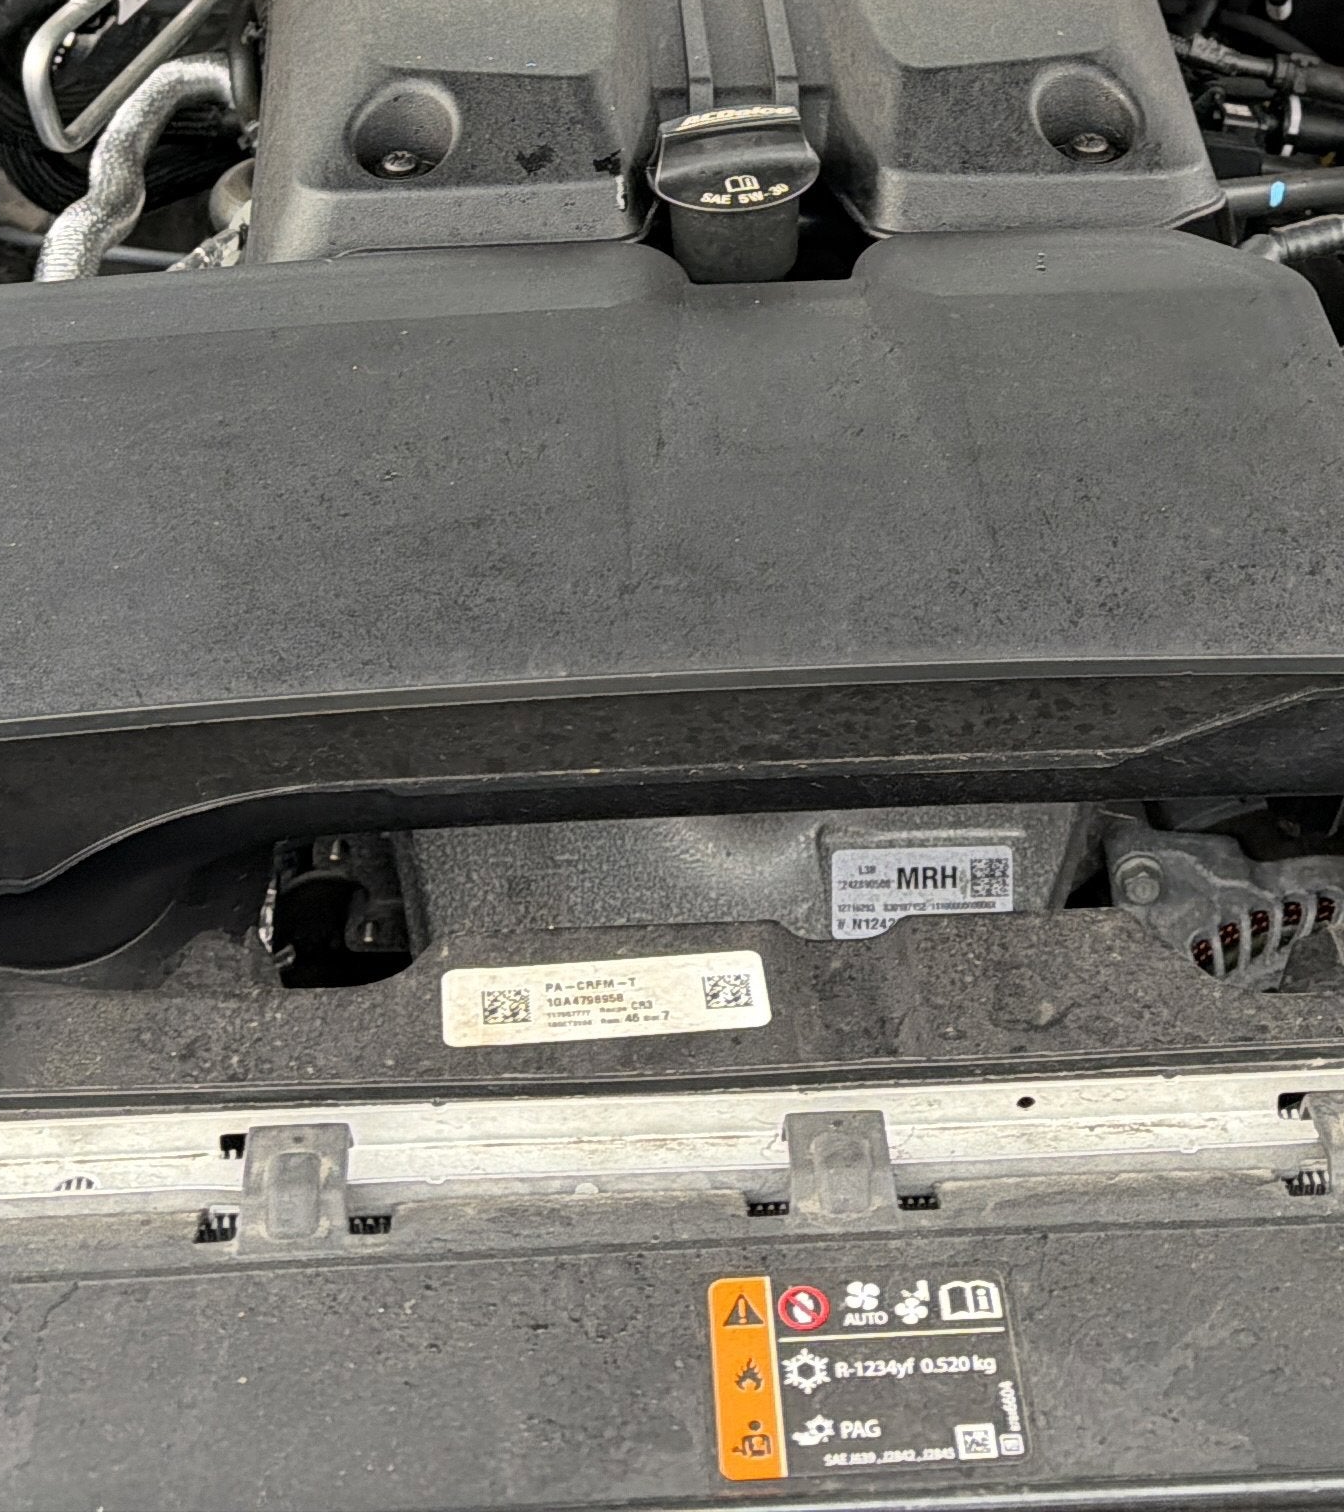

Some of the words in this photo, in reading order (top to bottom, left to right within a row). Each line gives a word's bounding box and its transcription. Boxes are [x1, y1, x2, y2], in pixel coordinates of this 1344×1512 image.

[700, 192, 732, 205] SAE
[738, 183, 789, 204] 5W-30
[896, 865, 958, 890] MRH
[843, 1311, 889, 1328] AUTO
[834, 1357, 916, 1379] R-1234yf
[920, 1355, 971, 1375] 0.520
[972, 1354, 997, 1376] kg
[840, 1419, 882, 1439] PAG
[823, 1452, 848, 1467] SAE
